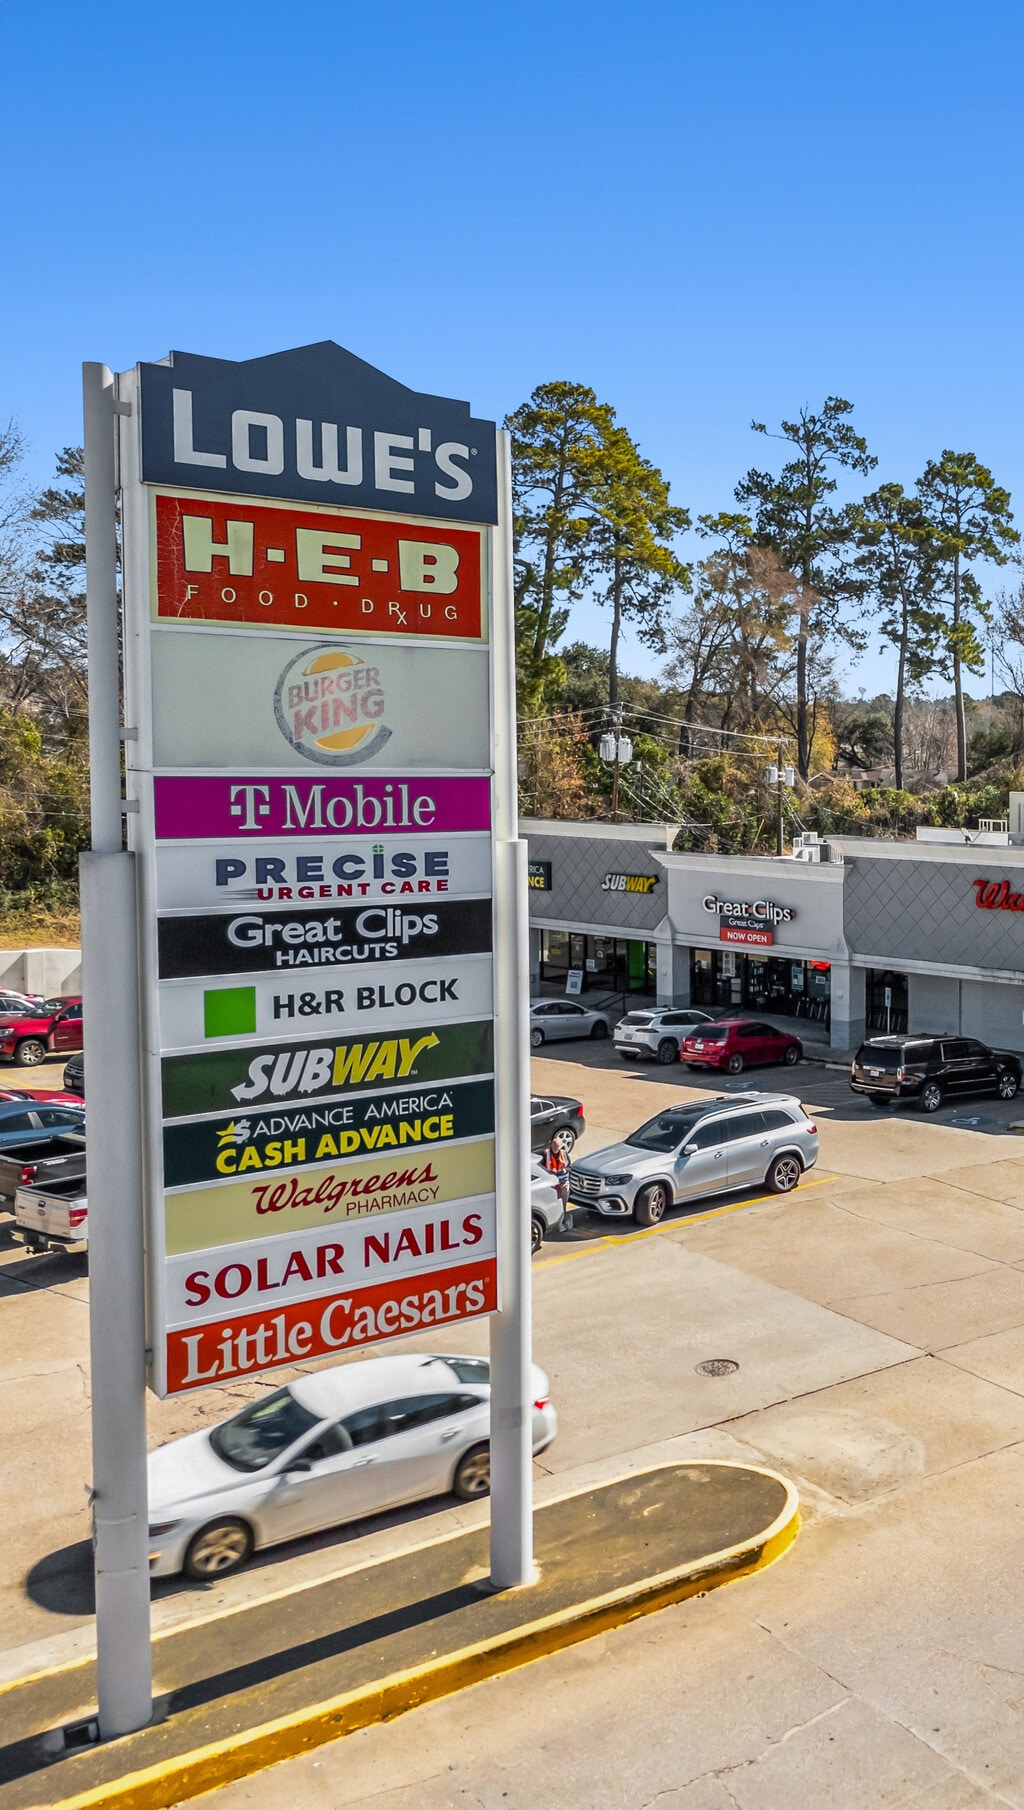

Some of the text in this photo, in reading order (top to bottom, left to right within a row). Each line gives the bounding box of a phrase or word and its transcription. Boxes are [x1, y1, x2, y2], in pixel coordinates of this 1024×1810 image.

[172, 388, 474, 501] LOWE'S
[182, 514, 460, 595] H-E-B
[187, 584, 309, 609] FOOD
[288, 667, 381, 710] BURGER
[293, 689, 385, 742] KING
[282, 784, 436, 829] Mobile
[257, 879, 449, 900] URGENT CARE
[601, 873, 657, 893] SUBWAY
[227, 909, 439, 948] Great Clips
[702, 895, 792, 925] Great Clips
[728, 917, 748, 927] Great
[276, 943, 398, 966] HAIRCUTS
[727, 931, 767, 943] NOW OPEN
[273, 978, 459, 1019] H&R BLOCK
[230, 1031, 440, 1101] SUBWAY
[254, 1094, 450, 1137] ADVANCE AMERICA
[215, 1115, 454, 1174] CASH ADVANCE
[251, 1163, 438, 1215] Walgreens
[346, 1186, 440, 1216] PHARMACY
[184, 1213, 483, 1307] SOLAR NAILS
[181, 1278, 485, 1384] Little Caesars
